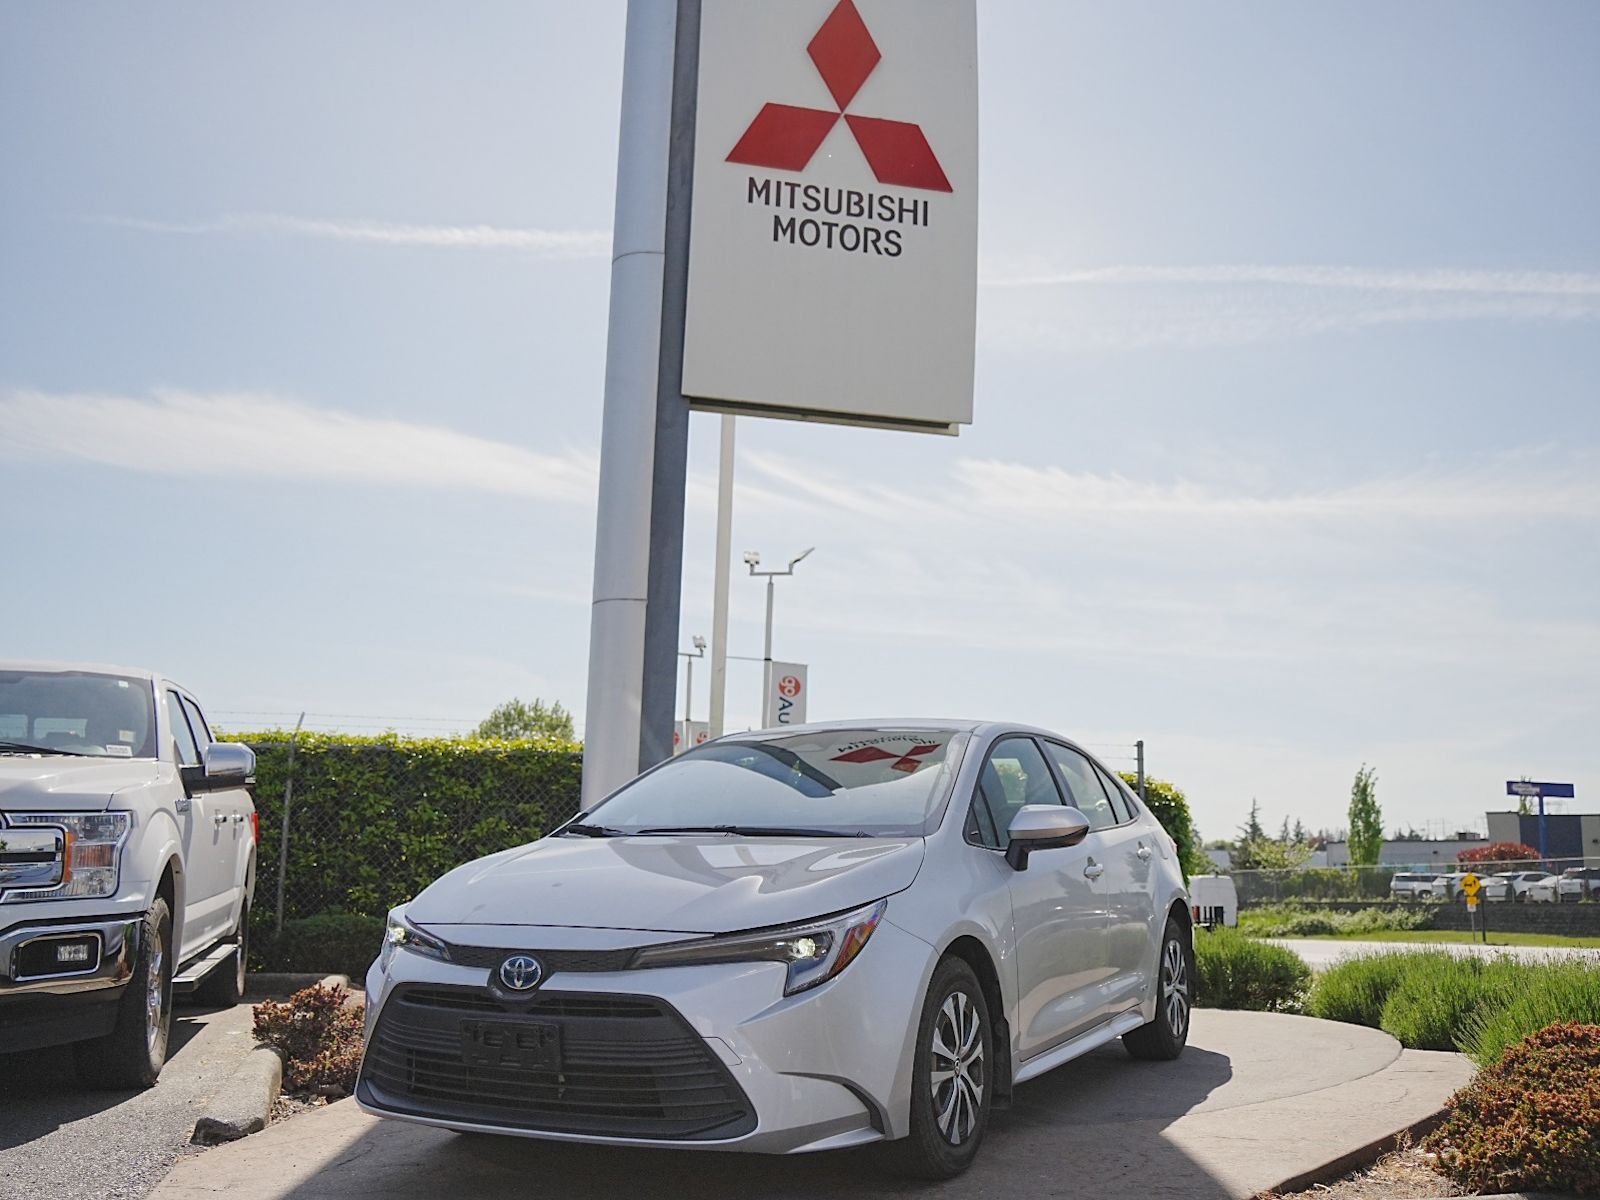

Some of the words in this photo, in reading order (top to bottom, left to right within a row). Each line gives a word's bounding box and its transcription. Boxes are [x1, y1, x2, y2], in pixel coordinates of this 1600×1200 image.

[748, 177, 928, 226] MITSUBISHI
[773, 215, 902, 257] MOTORS
[778, 697, 793, 725] Au
